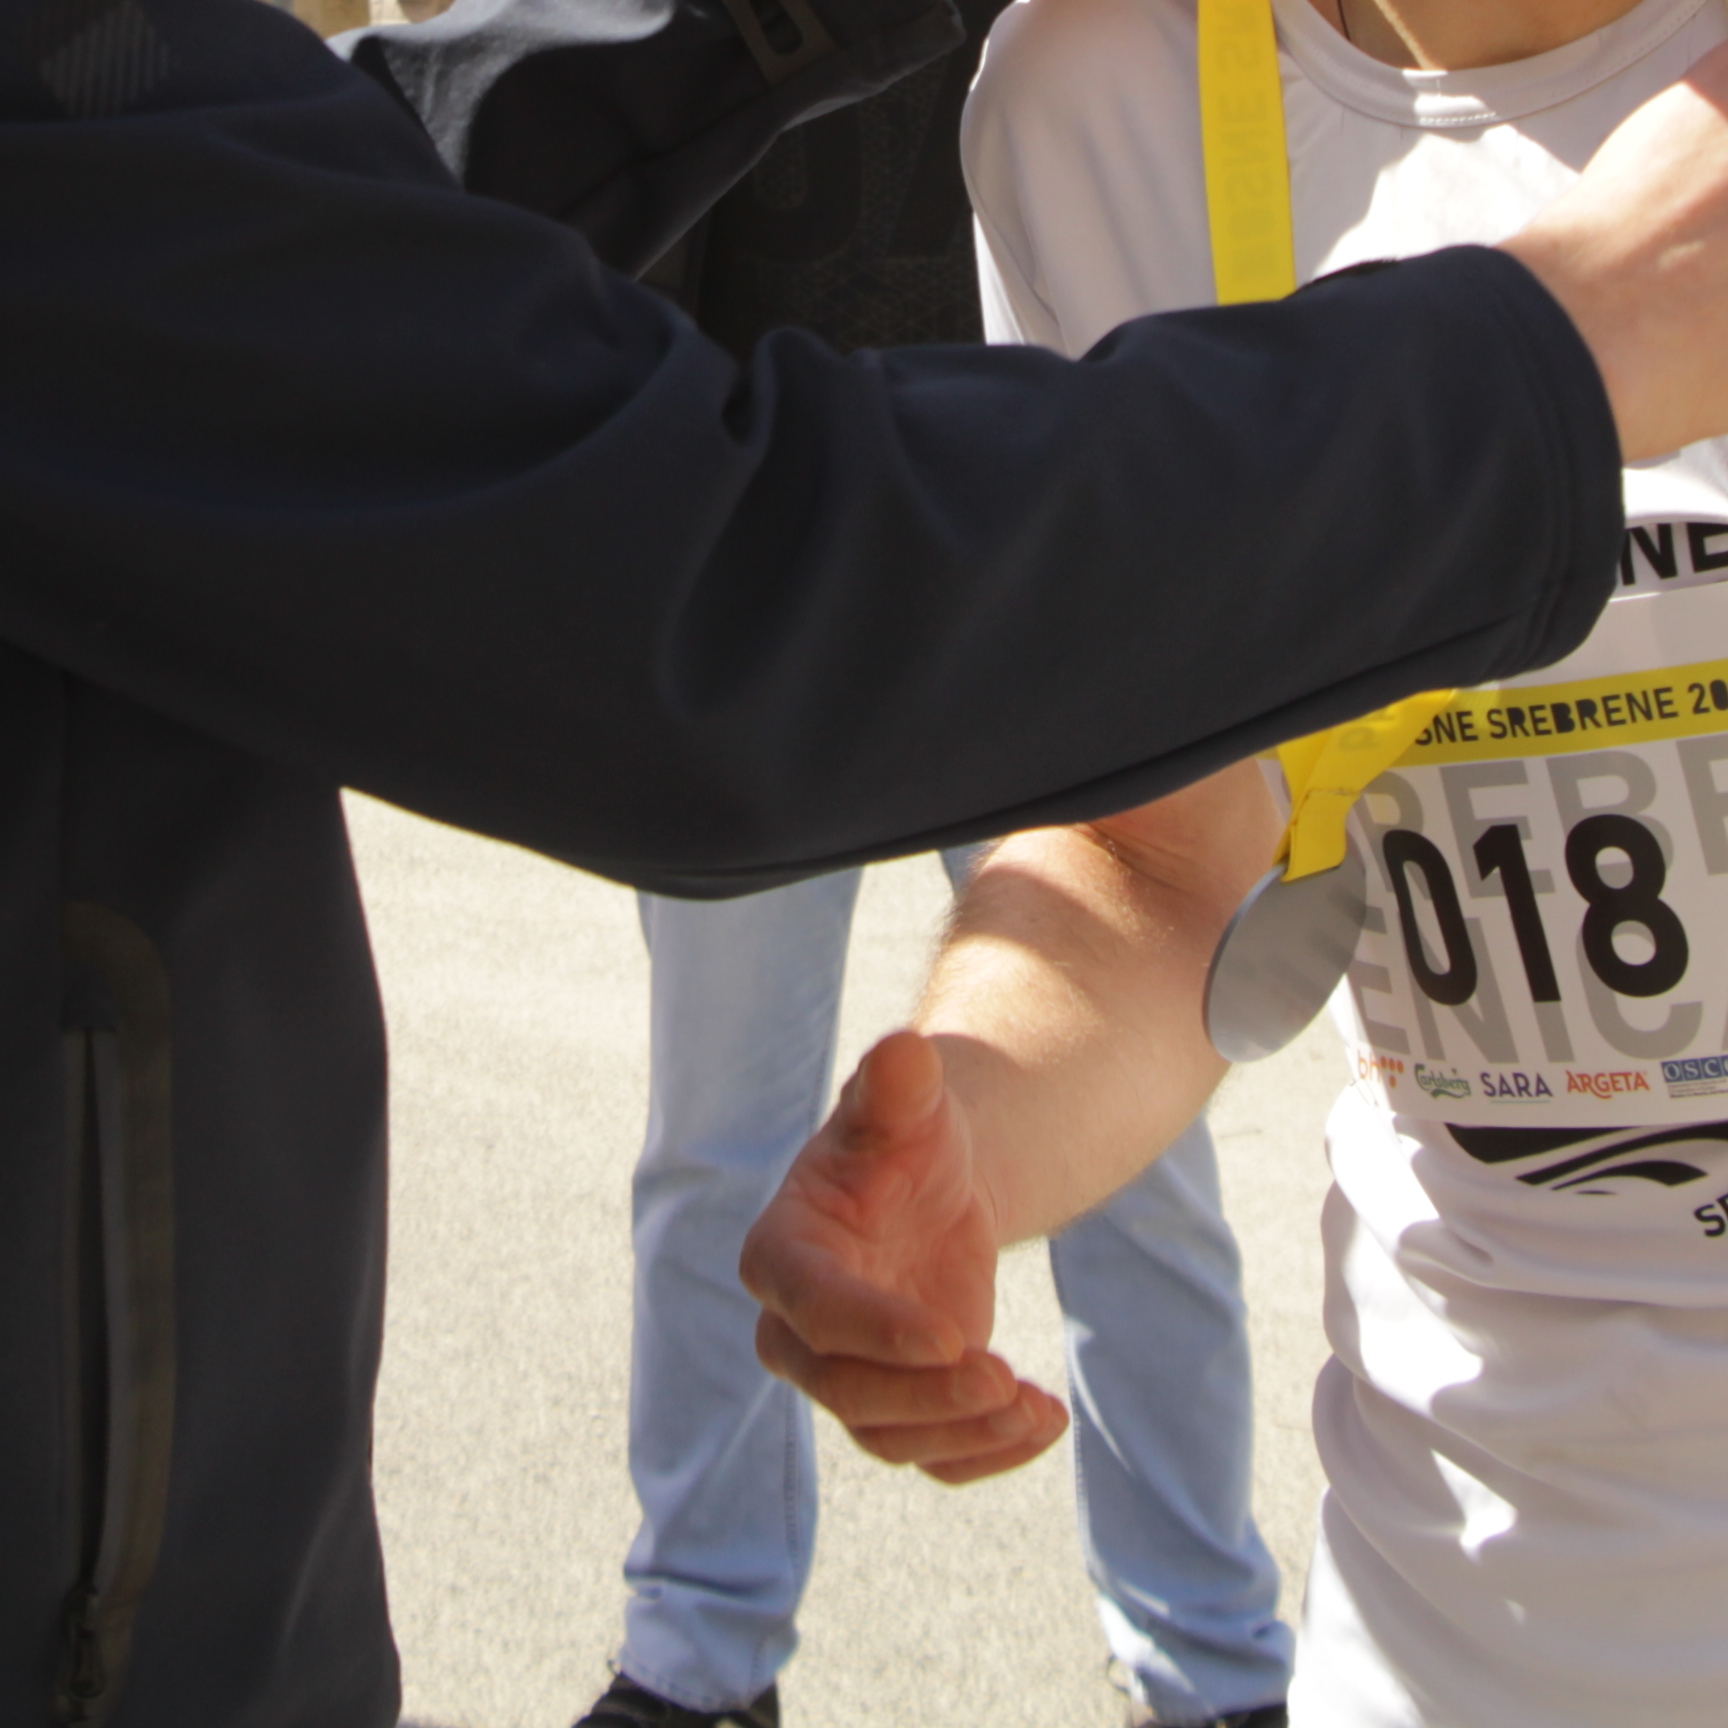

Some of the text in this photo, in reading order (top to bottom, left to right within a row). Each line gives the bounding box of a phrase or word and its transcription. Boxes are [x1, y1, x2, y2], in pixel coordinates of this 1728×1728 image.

[1486, 685, 1680, 740] SREBRENE
[1382, 813, 1690, 1007] 018
[1414, 1063, 1472, 1099] Carlsberg
[1480, 1071, 1554, 1099] SARA
[1565, 1069, 1651, 1100] ARGETA
